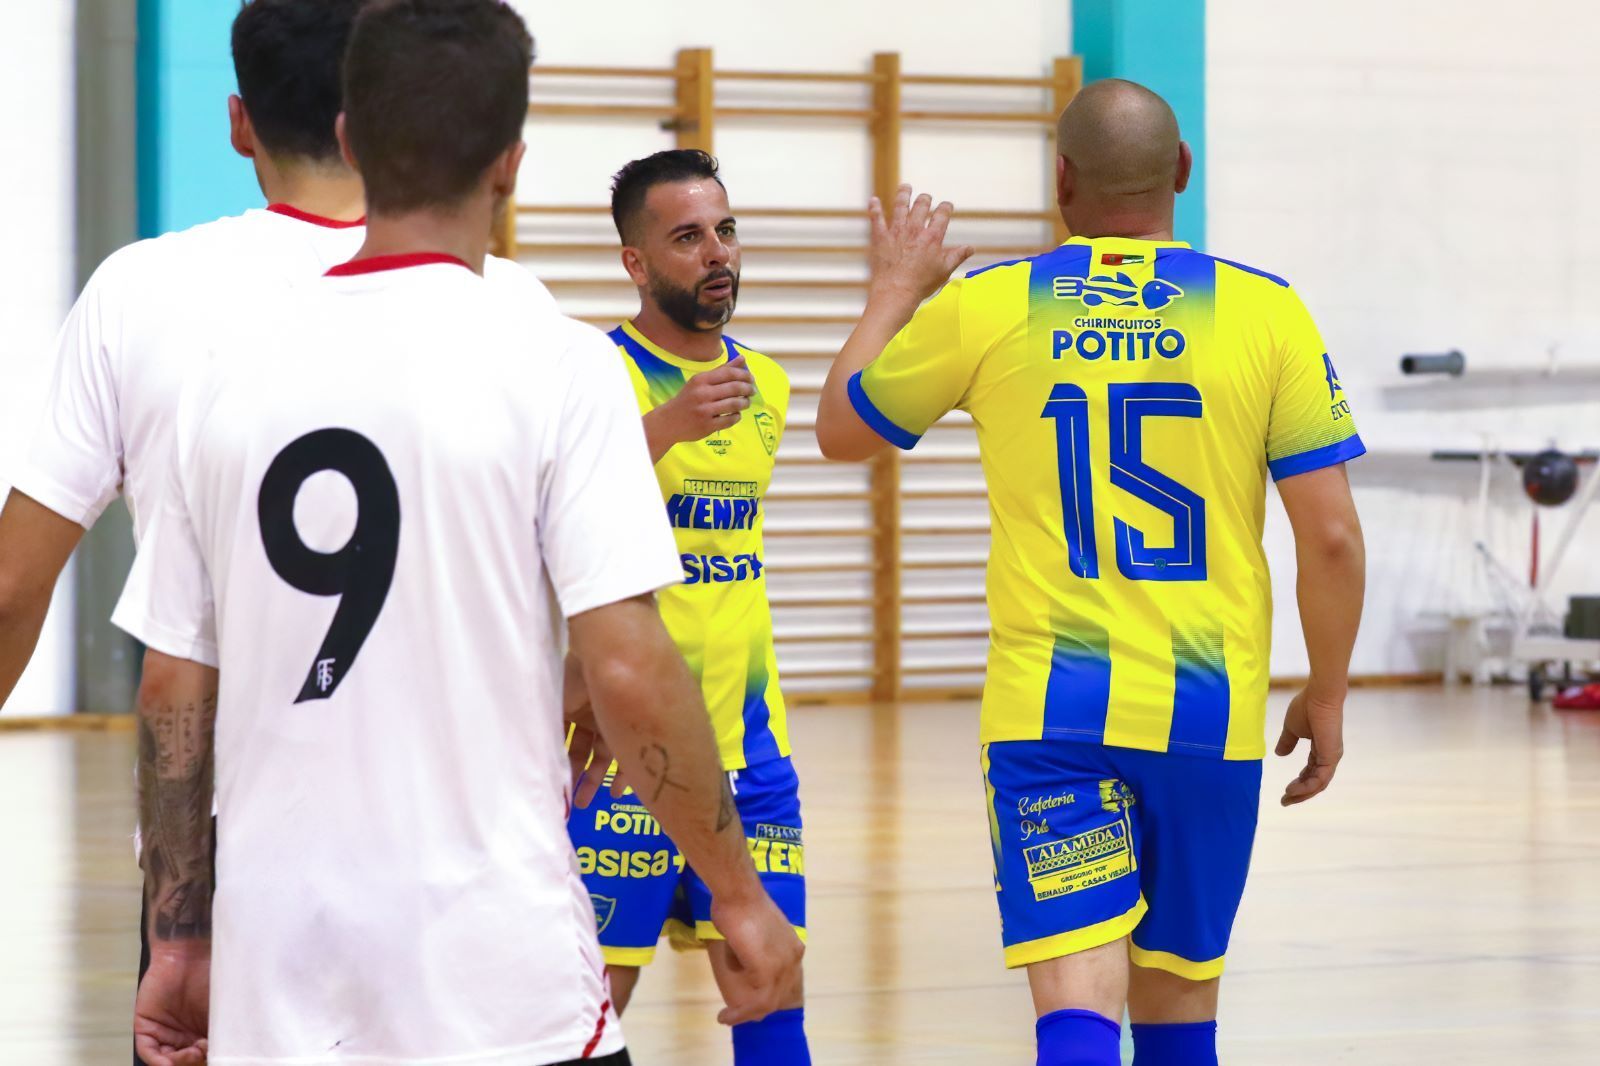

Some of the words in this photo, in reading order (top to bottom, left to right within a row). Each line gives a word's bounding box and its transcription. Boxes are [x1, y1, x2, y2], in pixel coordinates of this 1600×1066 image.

[1074, 318, 1161, 330] CHIRINGUITOS
[1052, 328, 1186, 361] POTITO
[1040, 382, 1208, 581] 15
[666, 493, 759, 530] HENRY
[257, 427, 402, 705] 9
[594, 809, 661, 836] POTIT
[1038, 828, 1116, 862] ALAMEDA
[1036, 884, 1075, 900] BENALUP
[1081, 874, 1108, 888] CASAS
[1108, 865, 1130, 879] VIEJAS
[1060, 868, 1093, 883] GREGORIO
